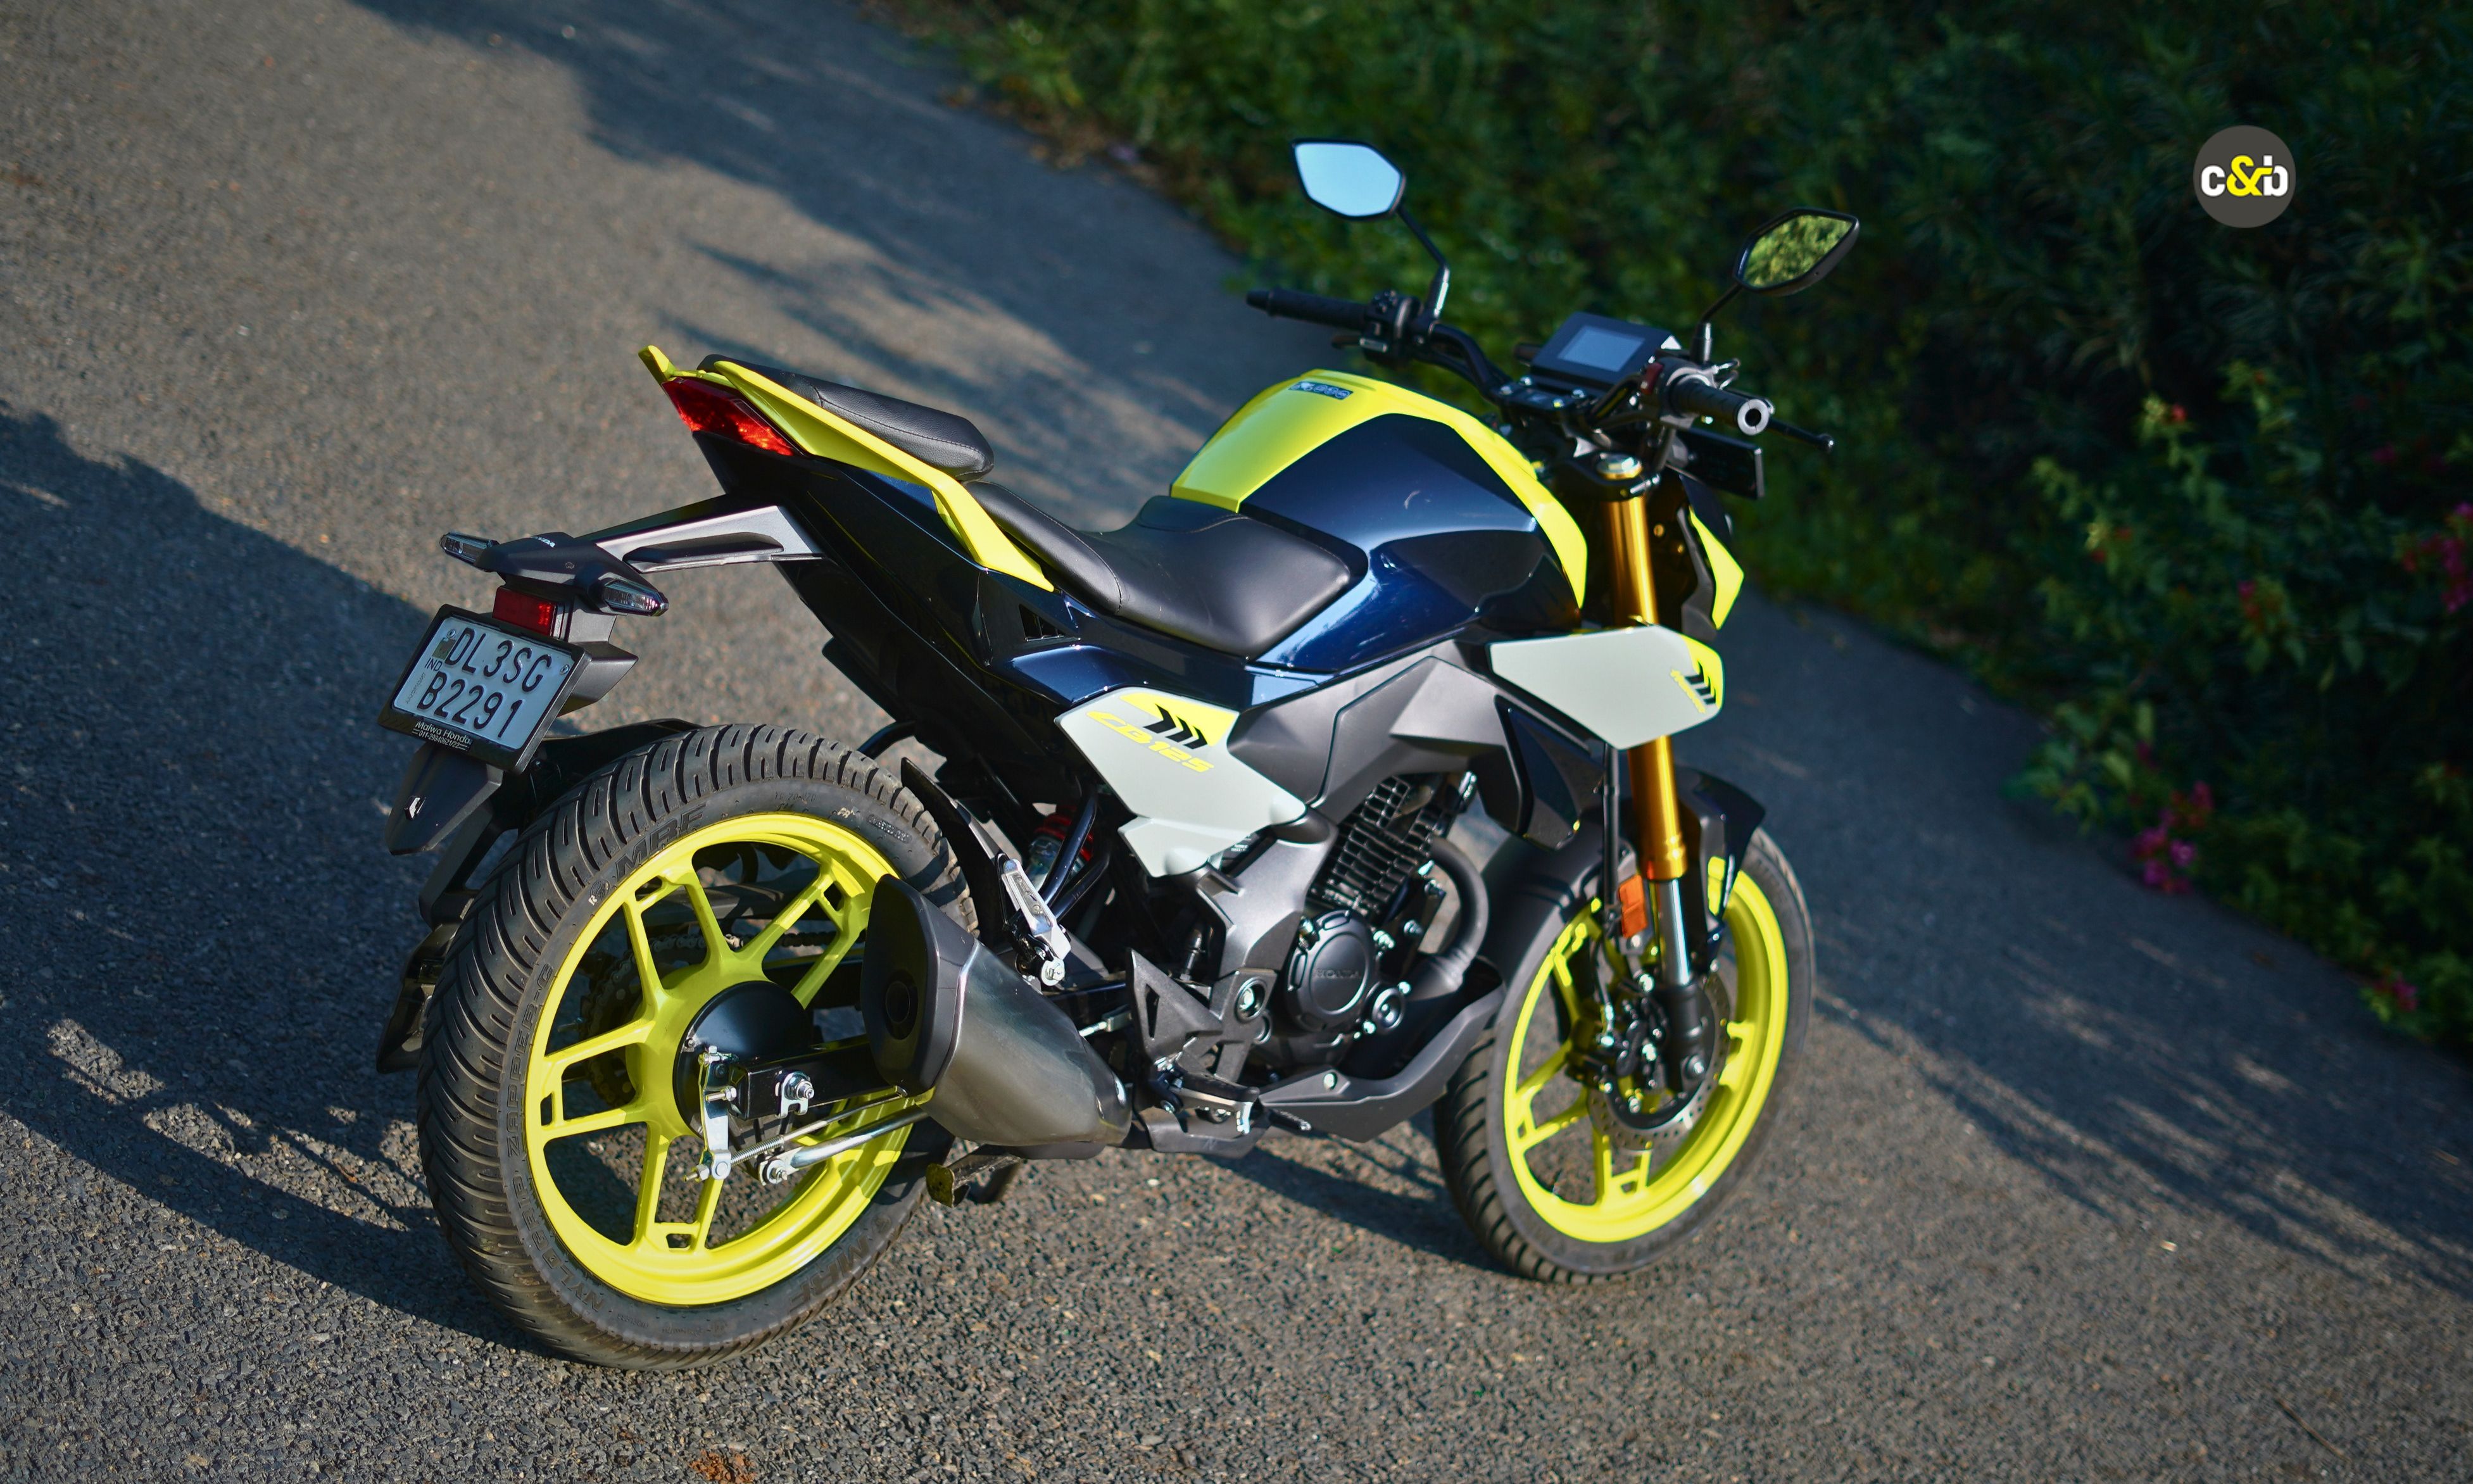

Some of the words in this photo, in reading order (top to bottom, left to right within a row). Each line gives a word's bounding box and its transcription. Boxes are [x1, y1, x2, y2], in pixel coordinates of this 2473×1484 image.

[424, 657, 443, 672] IND
[415, 721, 442, 735] Malwa
[443, 729, 470, 745] Honda
[417, 672, 523, 738] B2291
[1086, 711, 1214, 773] CB125
[615, 800, 707, 883] MRF
